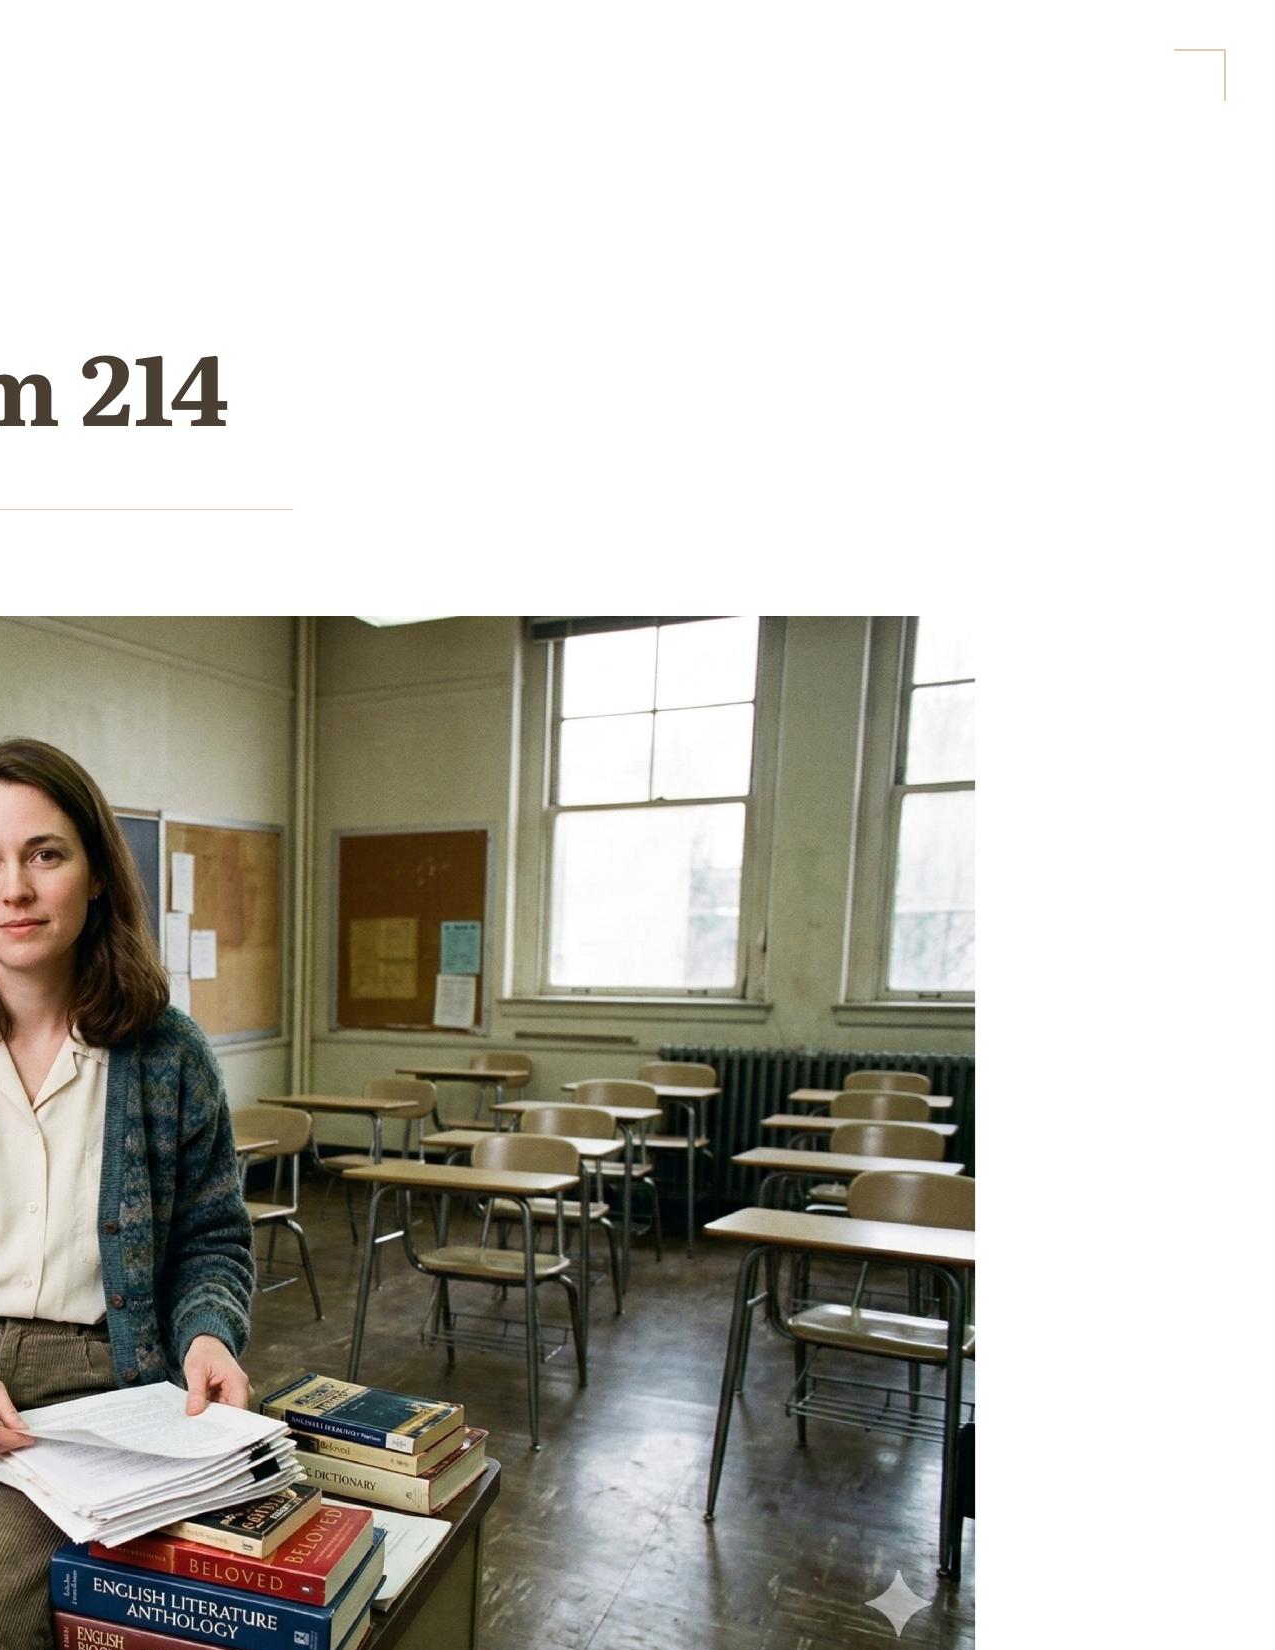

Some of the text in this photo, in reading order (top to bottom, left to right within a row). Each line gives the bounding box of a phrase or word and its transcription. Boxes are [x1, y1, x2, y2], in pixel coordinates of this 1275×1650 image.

[81, 354, 229, 427] 214
[319, 1440, 350, 1455] Beloved
[314, 1470, 377, 1491] DICTIONARY
[285, 1508, 343, 1564] BELOVED
[189, 1558, 283, 1591] BELOVED
[93, 1577, 165, 1606] ENGLISH
[171, 1594, 277, 1631] LITERATURE
[127, 1602, 239, 1640] ANTHOLOGY
[77, 1626, 124, 1650] ENGLISH
